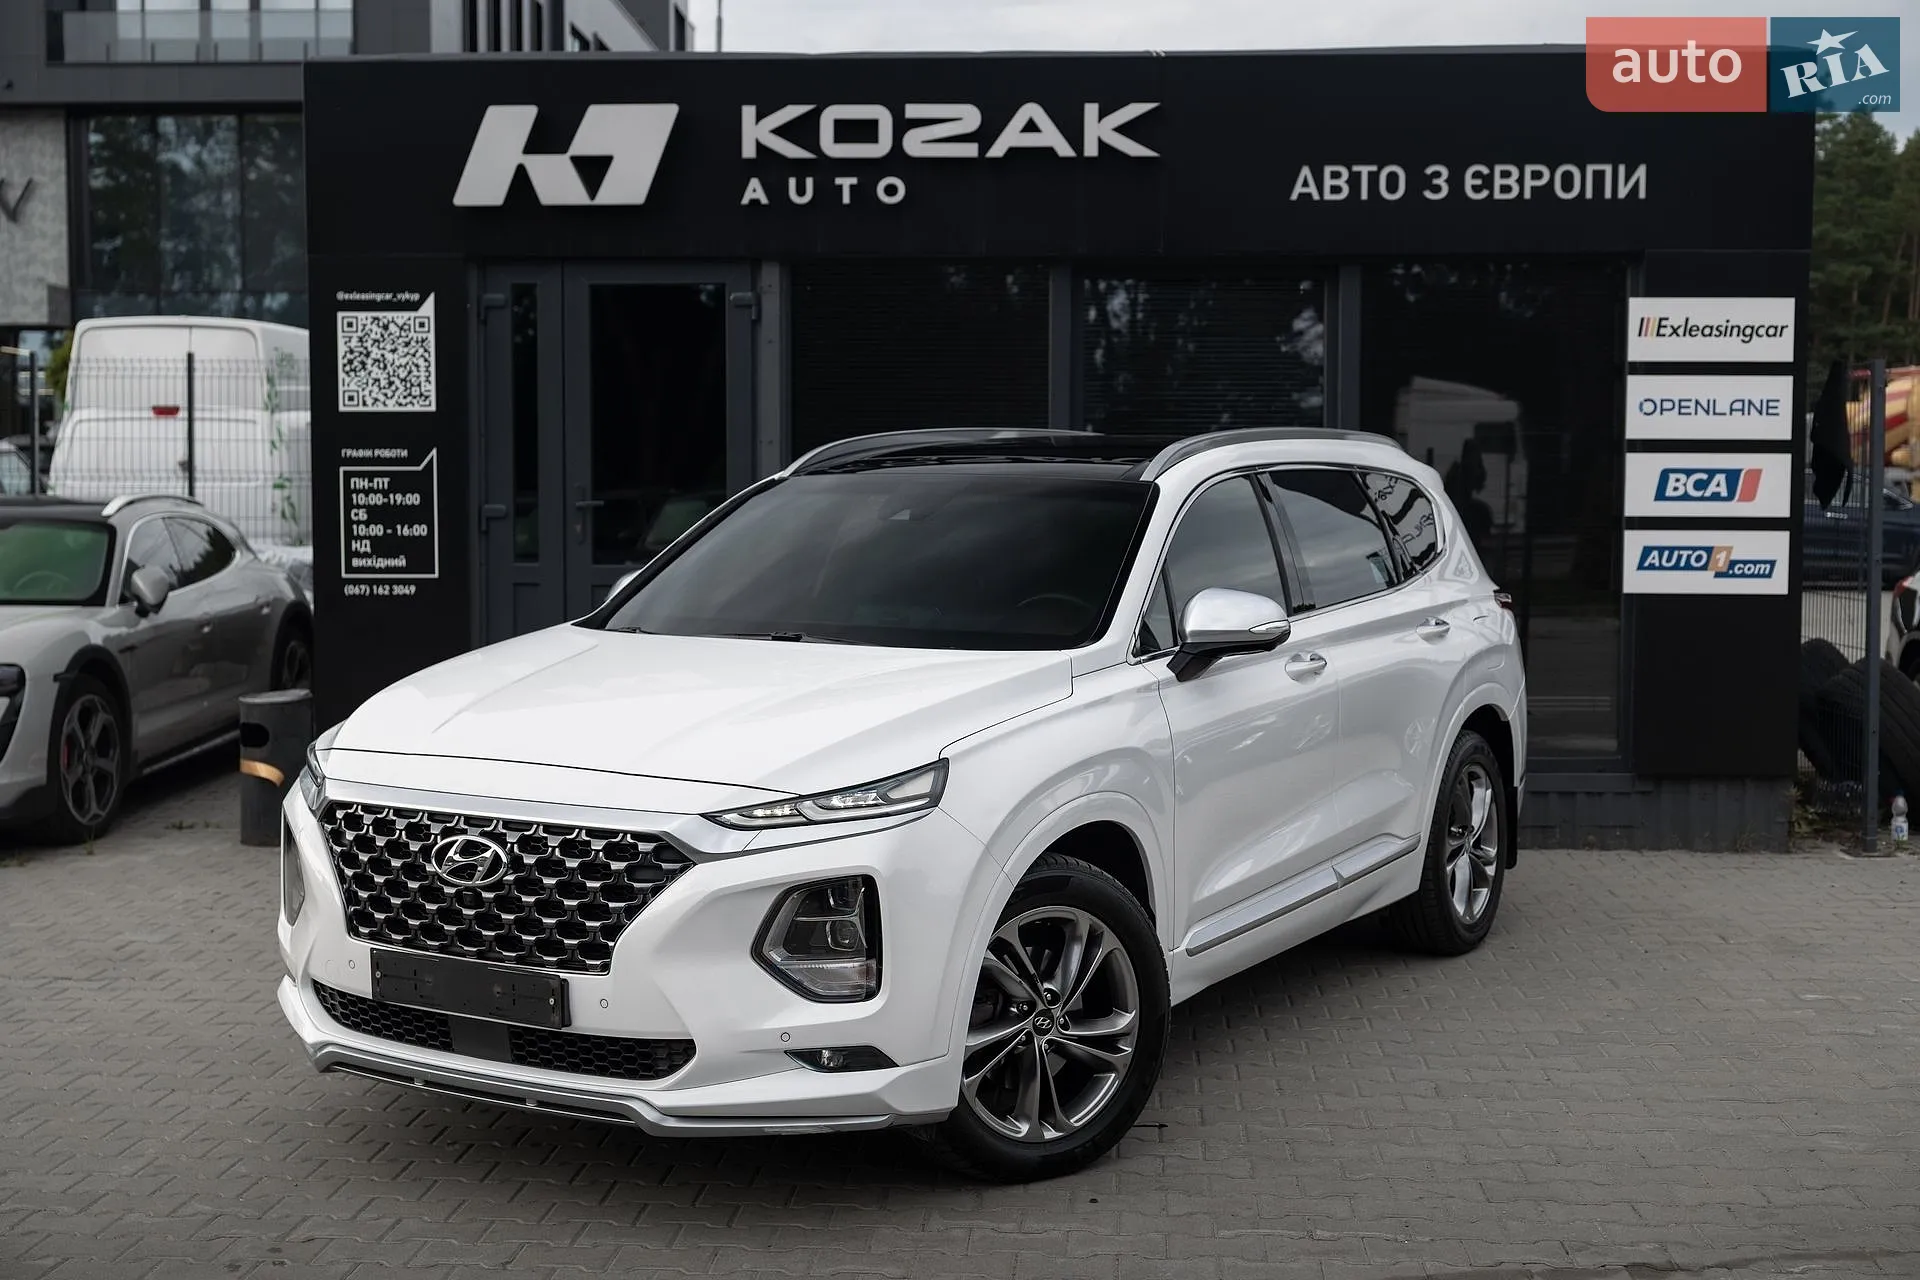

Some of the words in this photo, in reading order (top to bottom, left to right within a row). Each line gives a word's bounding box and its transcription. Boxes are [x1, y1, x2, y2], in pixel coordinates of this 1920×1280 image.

[741, 102, 1161, 159] KOZAK
[1290, 164, 1407, 201] АВТО
[1464, 163, 1648, 200] ЄВРОПИ
[741, 176, 906, 206] AUTO
[1639, 398, 1780, 416] OPENLANE
[374, 448, 408, 459] РОБОТИ
[350, 477, 391, 490] ПН-ПТ
[1665, 472, 1728, 498] BCA
[352, 493, 421, 506] 10:00-19:00
[350, 508, 368, 521] СБ
[352, 524, 384, 537] 10:00
[396, 524, 428, 537] 16:00
[351, 539, 371, 554] НД
[351, 554, 407, 569] вихідний
[343, 584, 371, 596] (067)
[372, 584, 391, 596] 162
[391, 584, 417, 596] 3049
